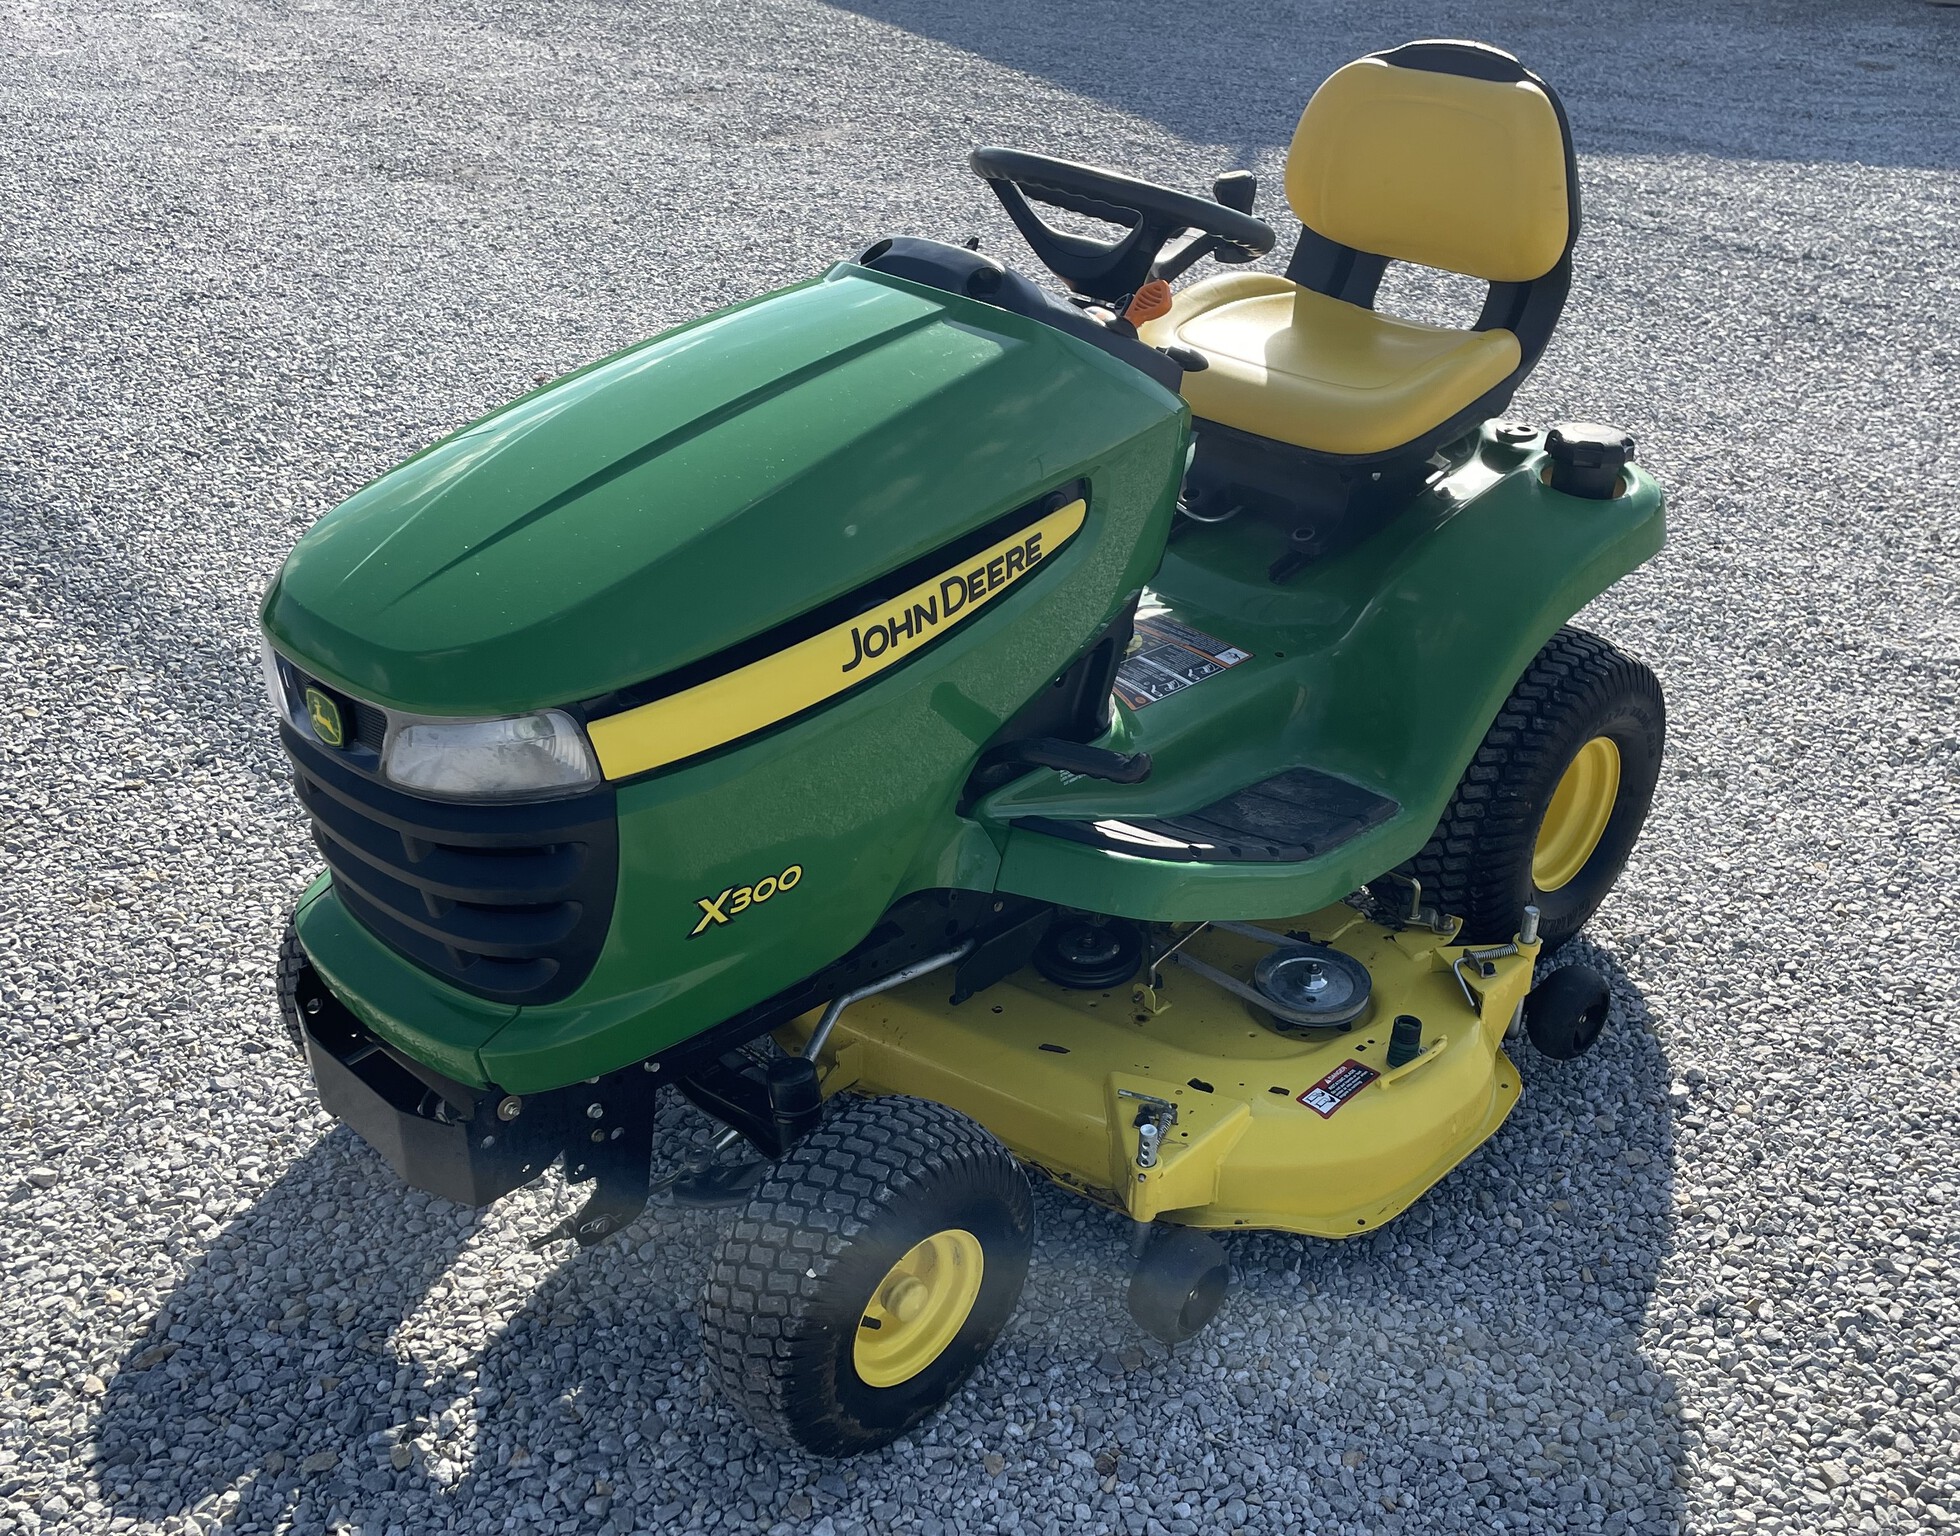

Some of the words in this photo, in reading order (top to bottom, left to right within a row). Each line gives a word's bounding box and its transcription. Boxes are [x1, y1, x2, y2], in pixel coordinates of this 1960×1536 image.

[842, 595, 938, 673] JOHN
[939, 531, 1043, 619] DEERE
[687, 863, 804, 939] X300
[1328, 1065, 1348, 1081] DANGER
